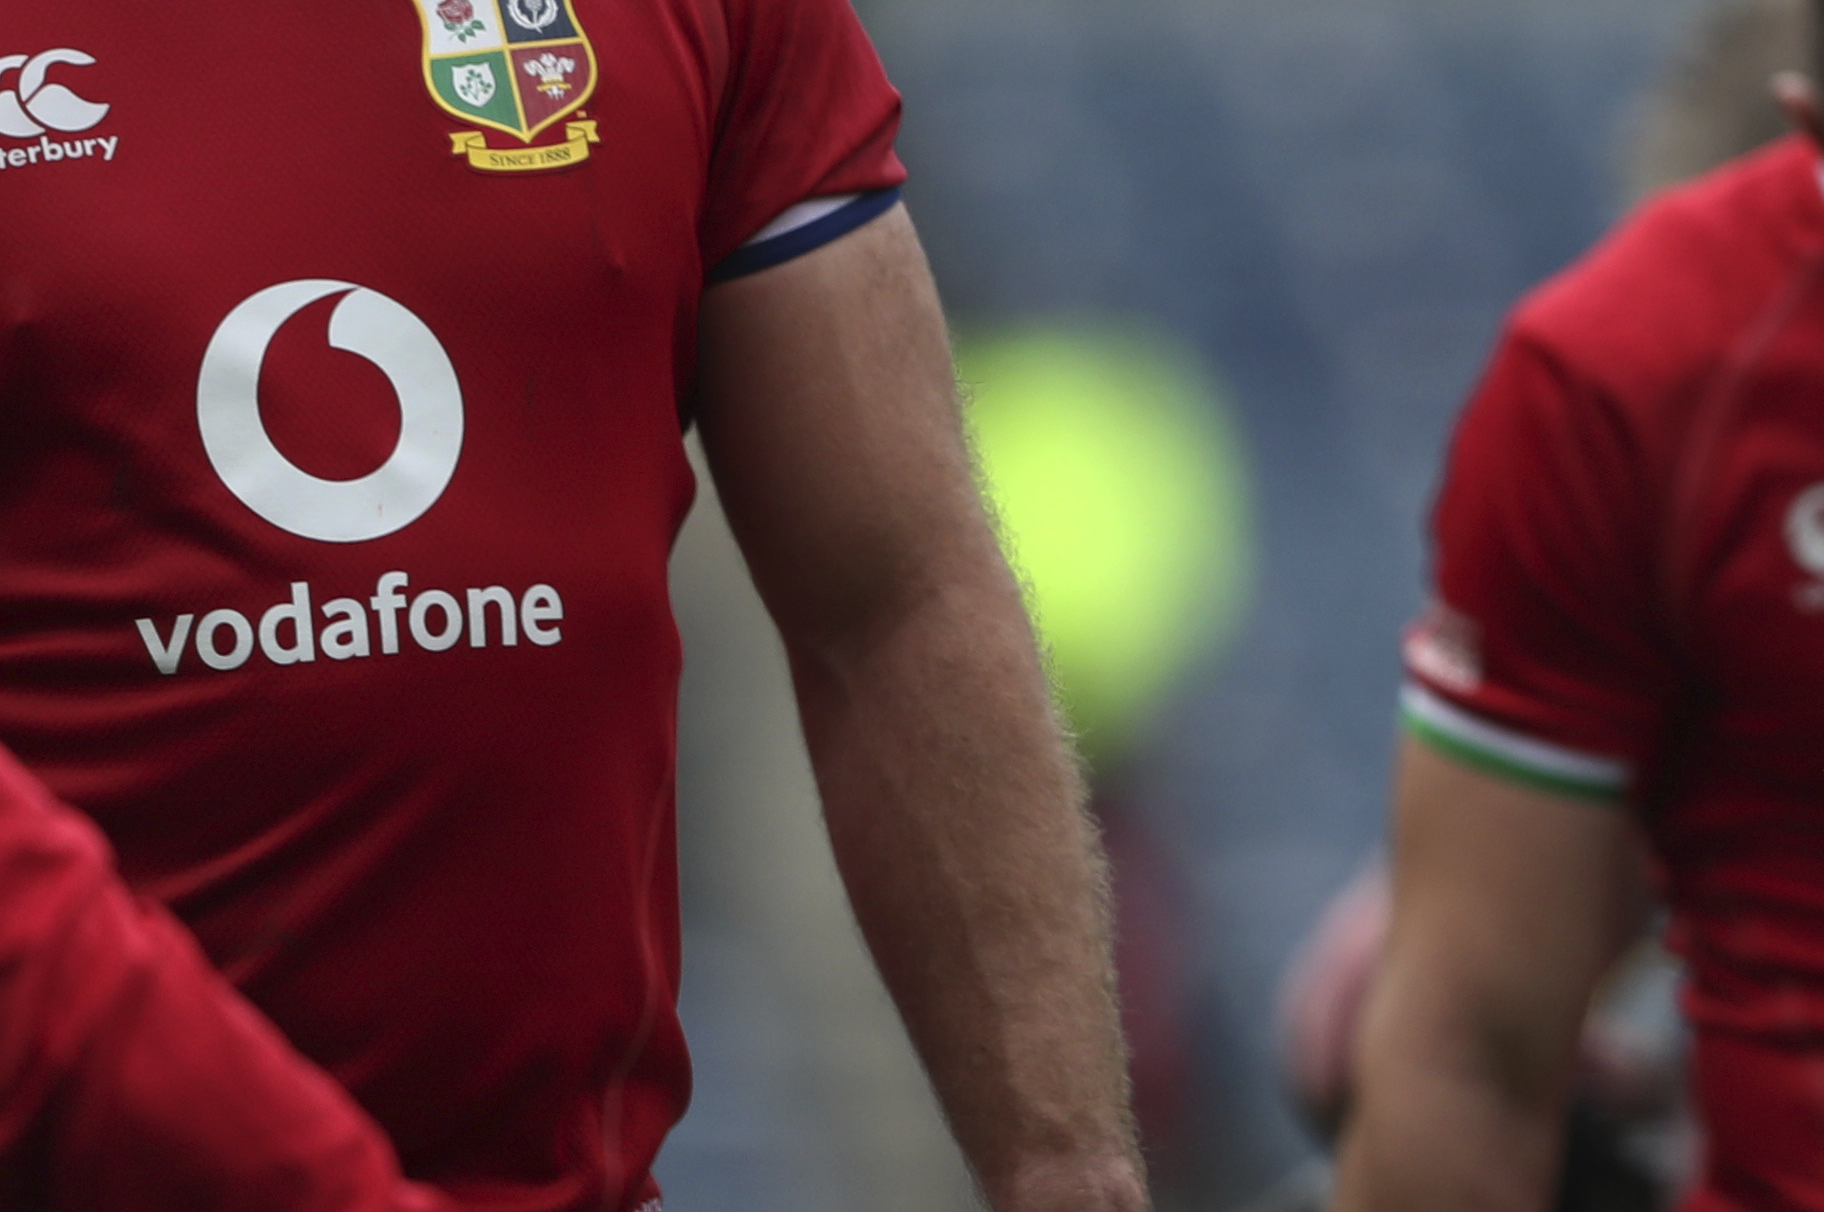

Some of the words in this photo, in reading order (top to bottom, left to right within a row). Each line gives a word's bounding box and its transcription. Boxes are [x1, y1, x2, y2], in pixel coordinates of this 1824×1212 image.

[489, 152, 534, 167] SINCE
[540, 147, 573, 163] 1888
[136, 572, 564, 675] vodafone
